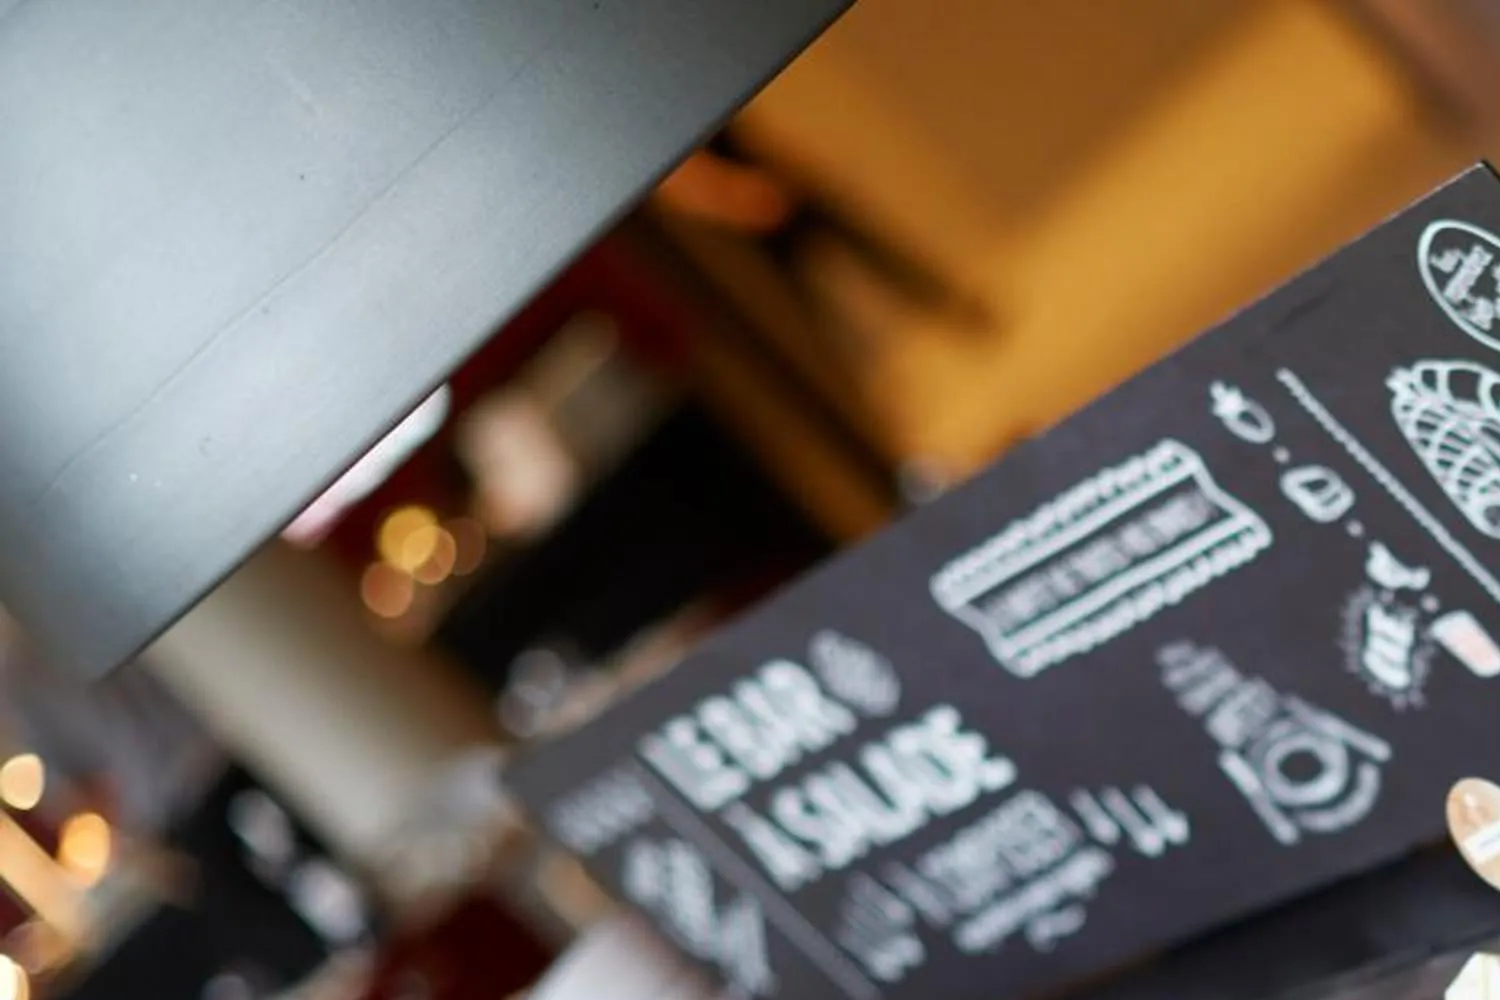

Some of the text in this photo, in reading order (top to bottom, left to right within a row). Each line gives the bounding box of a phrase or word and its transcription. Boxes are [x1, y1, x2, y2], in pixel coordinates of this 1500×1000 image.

[637, 714, 750, 812] LE
[697, 657, 858, 781] BAR
[772, 703, 1018, 870] SALADE
